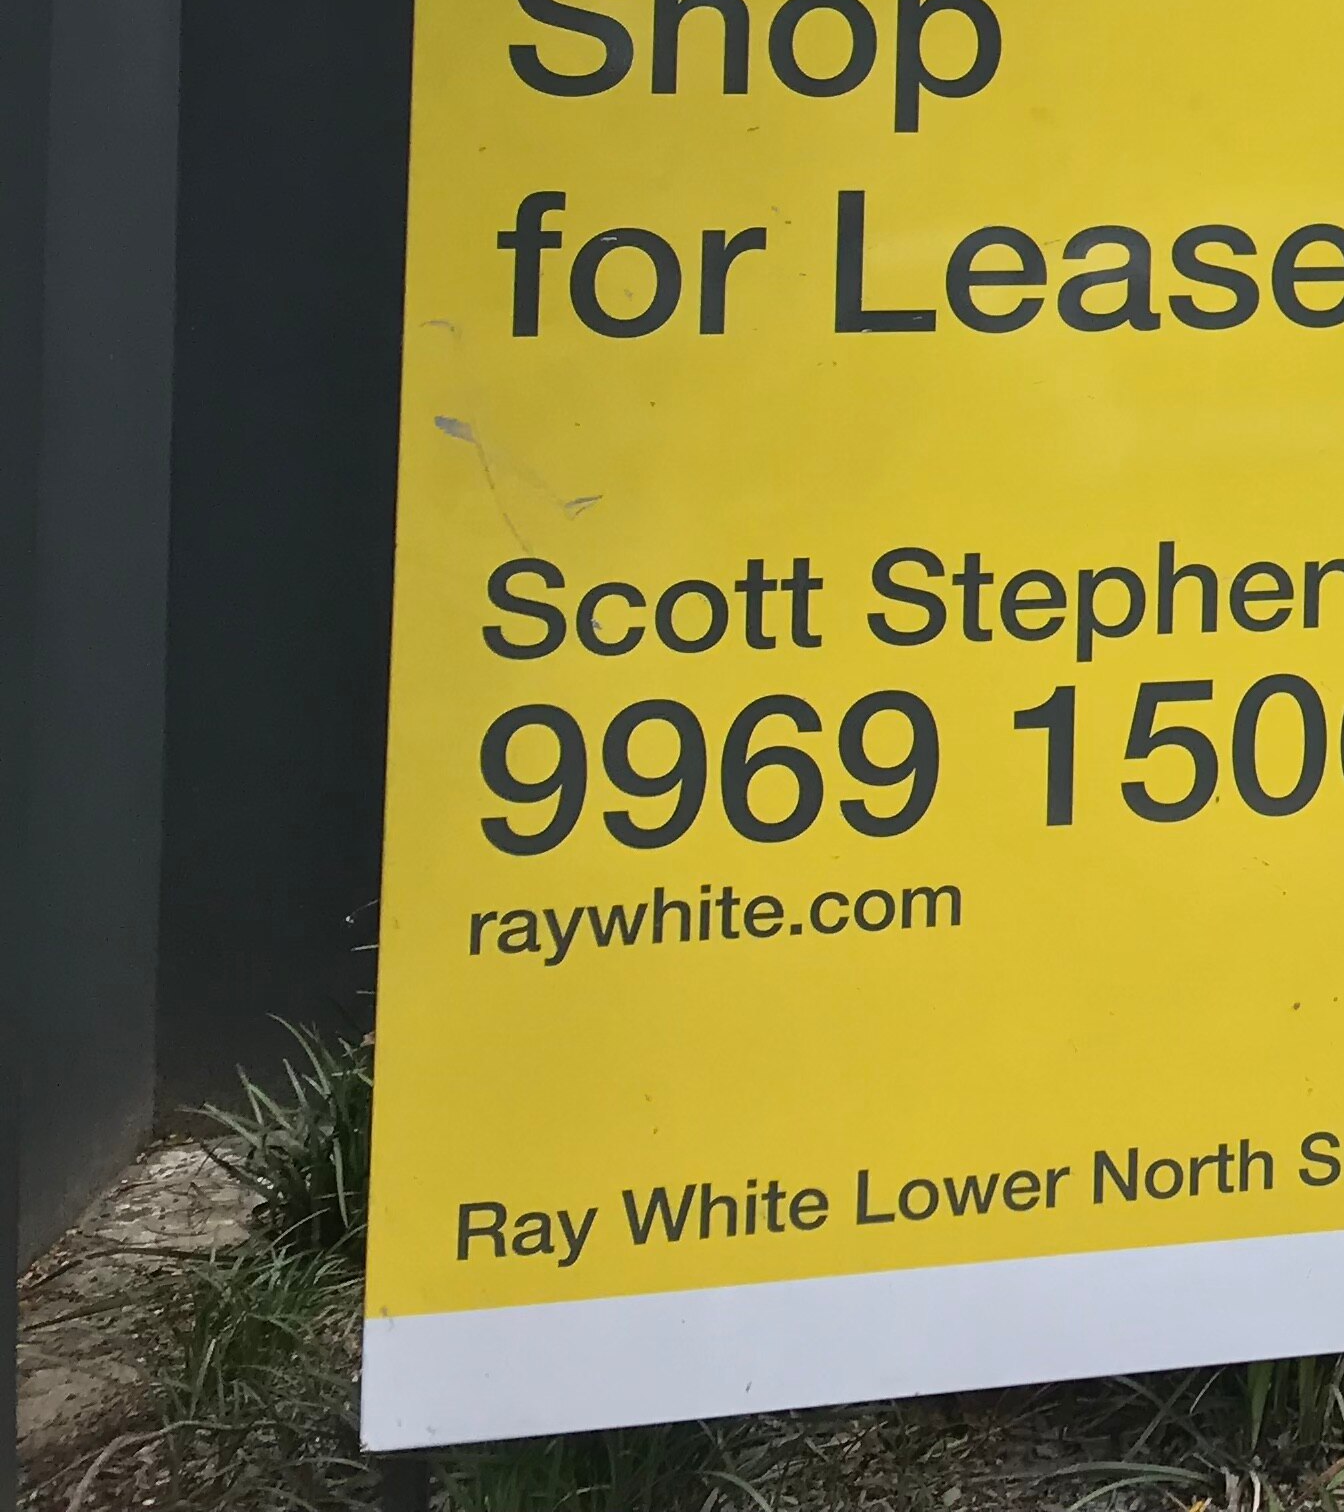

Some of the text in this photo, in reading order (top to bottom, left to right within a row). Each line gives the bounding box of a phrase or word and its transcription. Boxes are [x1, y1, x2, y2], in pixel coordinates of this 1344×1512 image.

[495, 189, 769, 340] for
[481, 556, 825, 662] Scott
[478, 688, 941, 858] 9969
[468, 883, 962, 968] raywhite.com
[455, 1200, 600, 1269] Ray
[620, 1177, 830, 1247] White
[855, 1165, 1072, 1226] Lower
[1092, 1137, 1275, 1206] North
